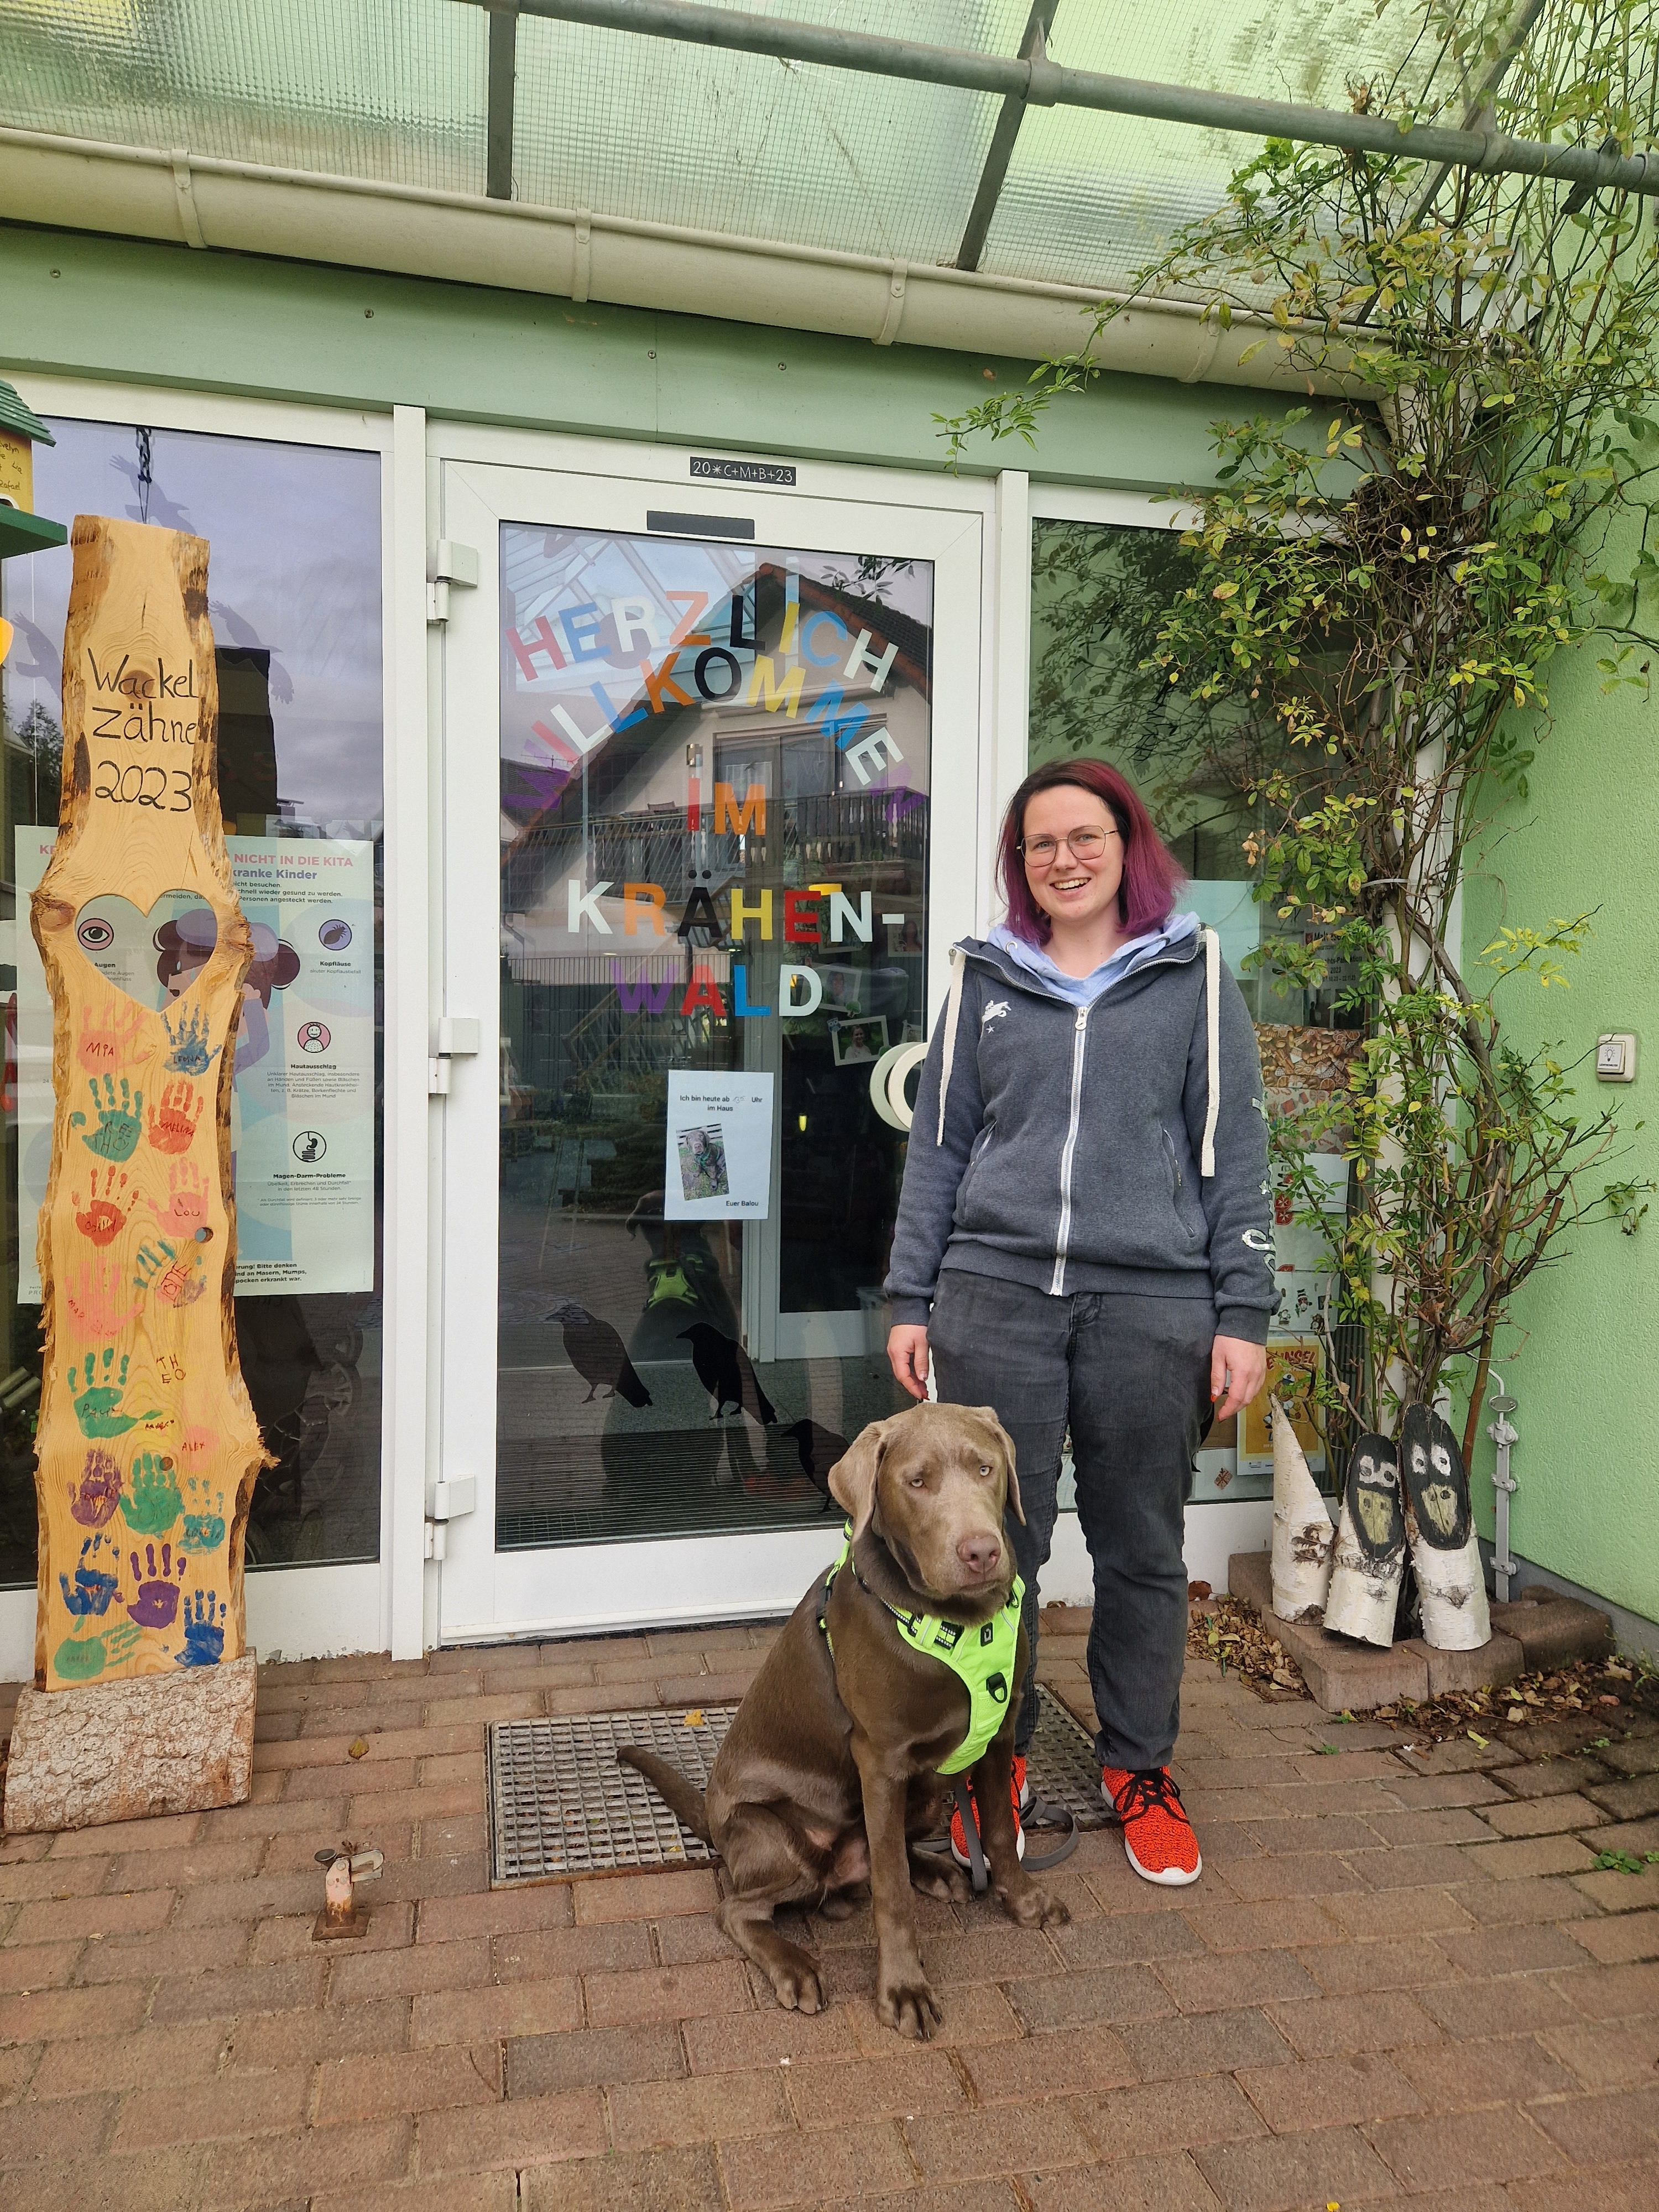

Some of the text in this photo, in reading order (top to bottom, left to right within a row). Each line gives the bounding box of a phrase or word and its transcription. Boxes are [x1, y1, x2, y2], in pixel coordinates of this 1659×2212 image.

[505, 591, 899, 692] HERZLICH
[88, 648, 199, 699] Wackel
[92, 701, 198, 745] Zähne
[502, 646, 926, 823] WILLKOMMEN
[95, 760, 192, 813] 2023
[687, 777, 766, 836] IM
[234, 853, 353, 867] NICHT IN DIE KITA
[276, 869, 317, 879] Kinder
[567, 869, 905, 943] KRÄHEN-
[610, 958, 823, 1017] WALD
[174, 1208, 200, 1217] LOU
